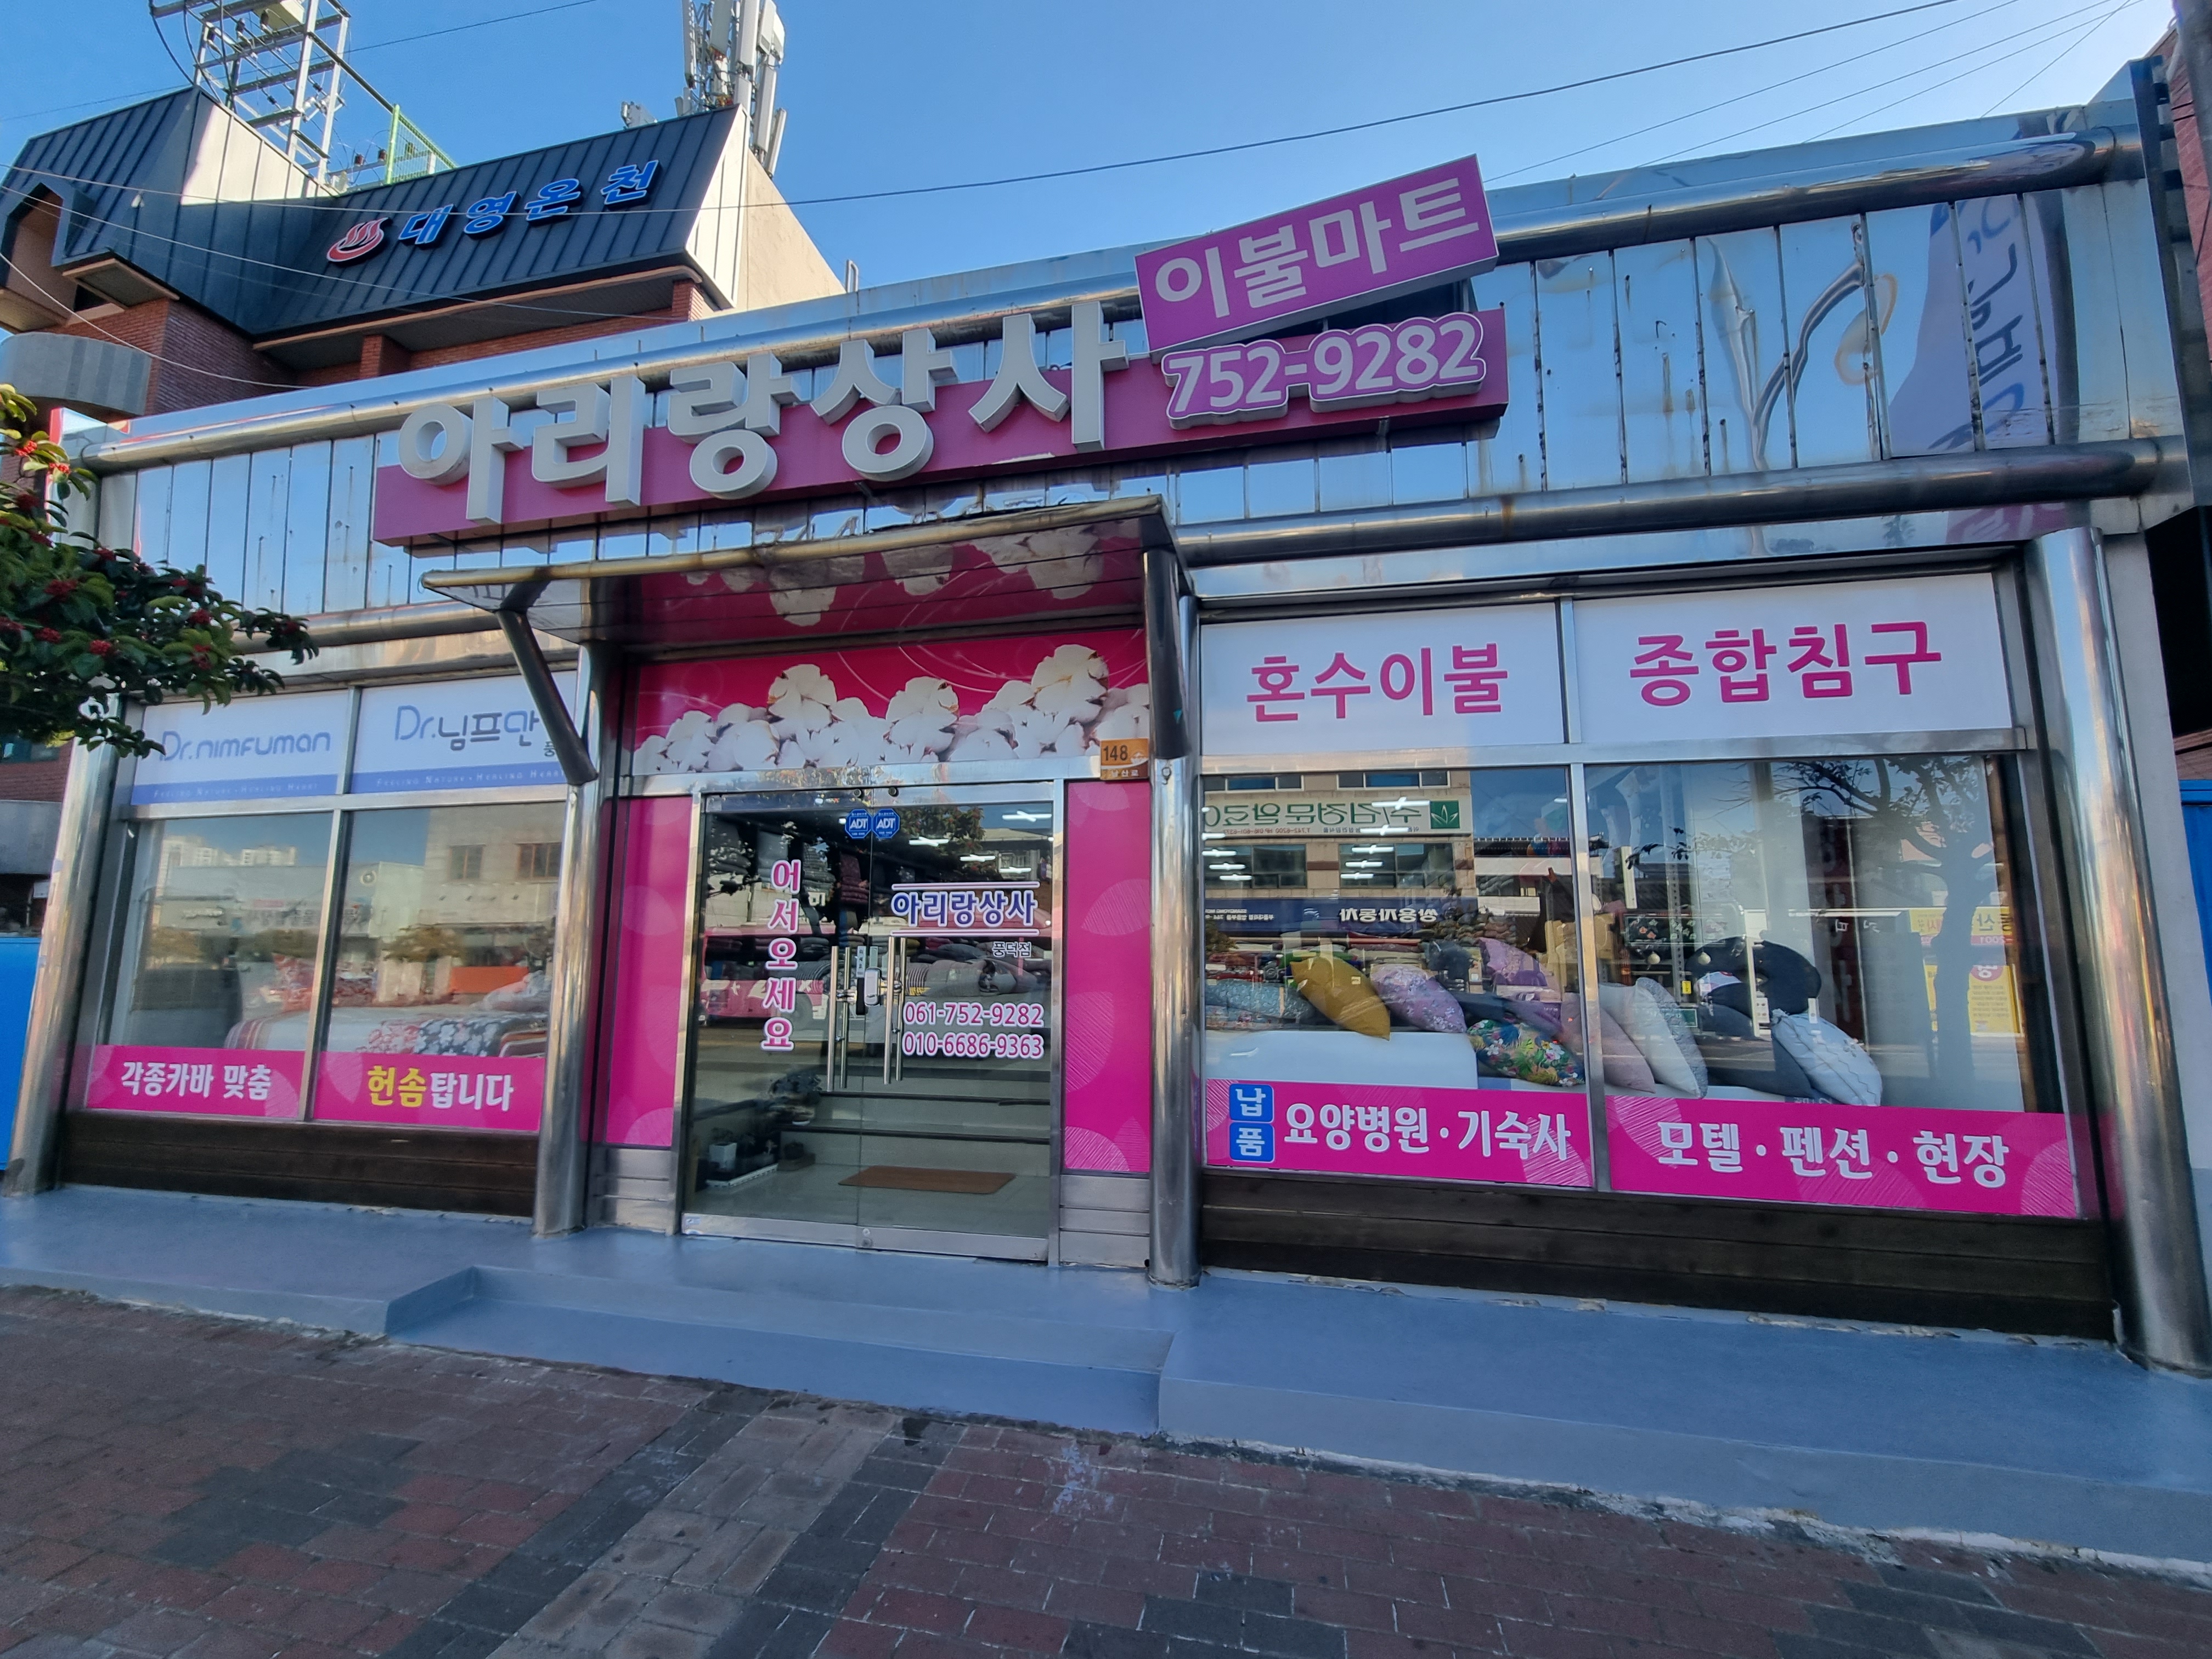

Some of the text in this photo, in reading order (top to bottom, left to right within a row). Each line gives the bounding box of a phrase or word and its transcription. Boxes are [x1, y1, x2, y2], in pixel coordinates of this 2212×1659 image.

[398, 160, 658, 245] 대영온천
[1155, 178, 1480, 318] 이불마트
[1168, 319, 1479, 413] 752-9282
[398, 301, 1128, 525] 아리랑상사
[1246, 641, 1508, 724] 혼수이불
[1629, 620, 1942, 707] 종합침구
[1103, 744, 1128, 761] 148
[849, 817, 868, 829] ADT
[876, 817, 896, 829] ADT
[891, 890, 1039, 927] 아리랑상사
[762, 860, 800, 1051] 어서오세요
[992, 941, 1032, 958] 풍덕점
[903, 1001, 1044, 1028] 061-752-9282
[902, 1031, 1045, 1060] 010-6686-9363
[121, 1060, 272, 1101] 각종카바 맞춤
